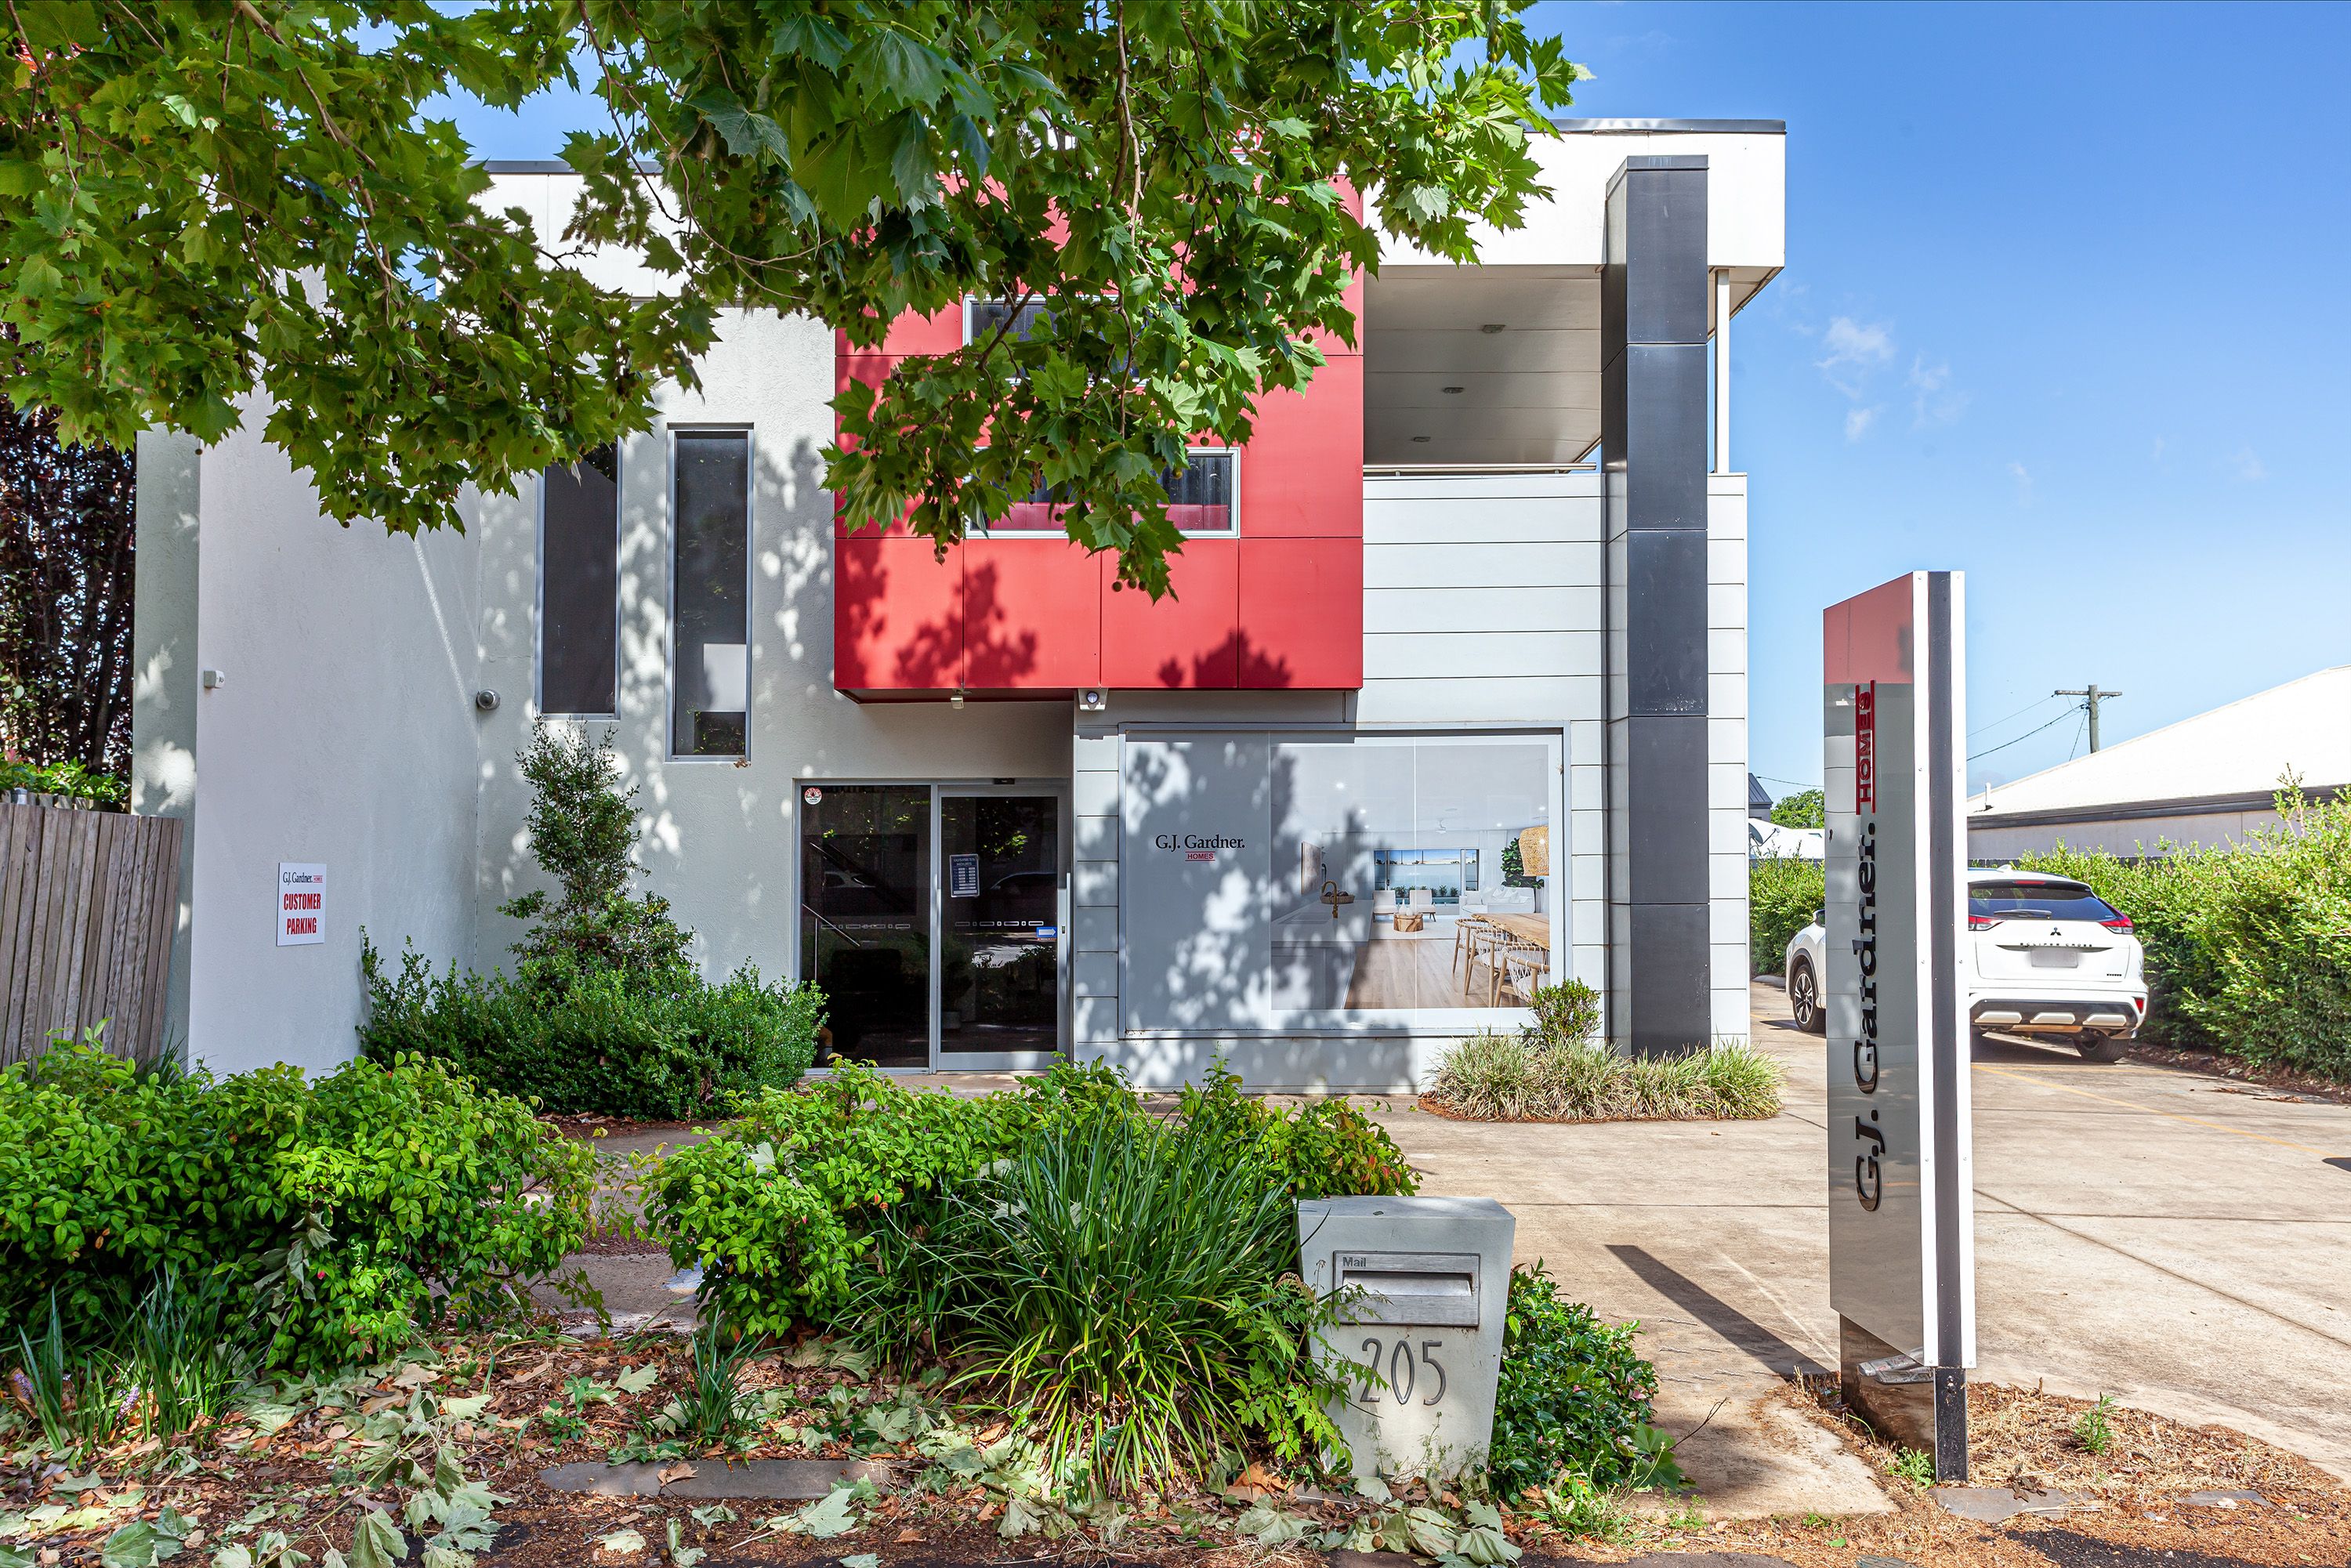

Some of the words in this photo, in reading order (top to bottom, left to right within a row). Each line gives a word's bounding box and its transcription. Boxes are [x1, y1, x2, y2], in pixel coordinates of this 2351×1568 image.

[1858, 690, 1871, 804] HOMES
[1155, 835, 1180, 852] G.J.
[1184, 834, 1245, 849] Gardner.
[292, 872, 313, 883] Gardner.
[284, 893, 321, 910] CUSTOMER
[286, 917, 317, 934] PARKING
[1852, 822, 1879, 1095] Gardner.
[1855, 1109, 1886, 1211] G.J.
[1342, 1257, 1367, 1268] Mail
[1360, 1338, 1446, 1405] 205
